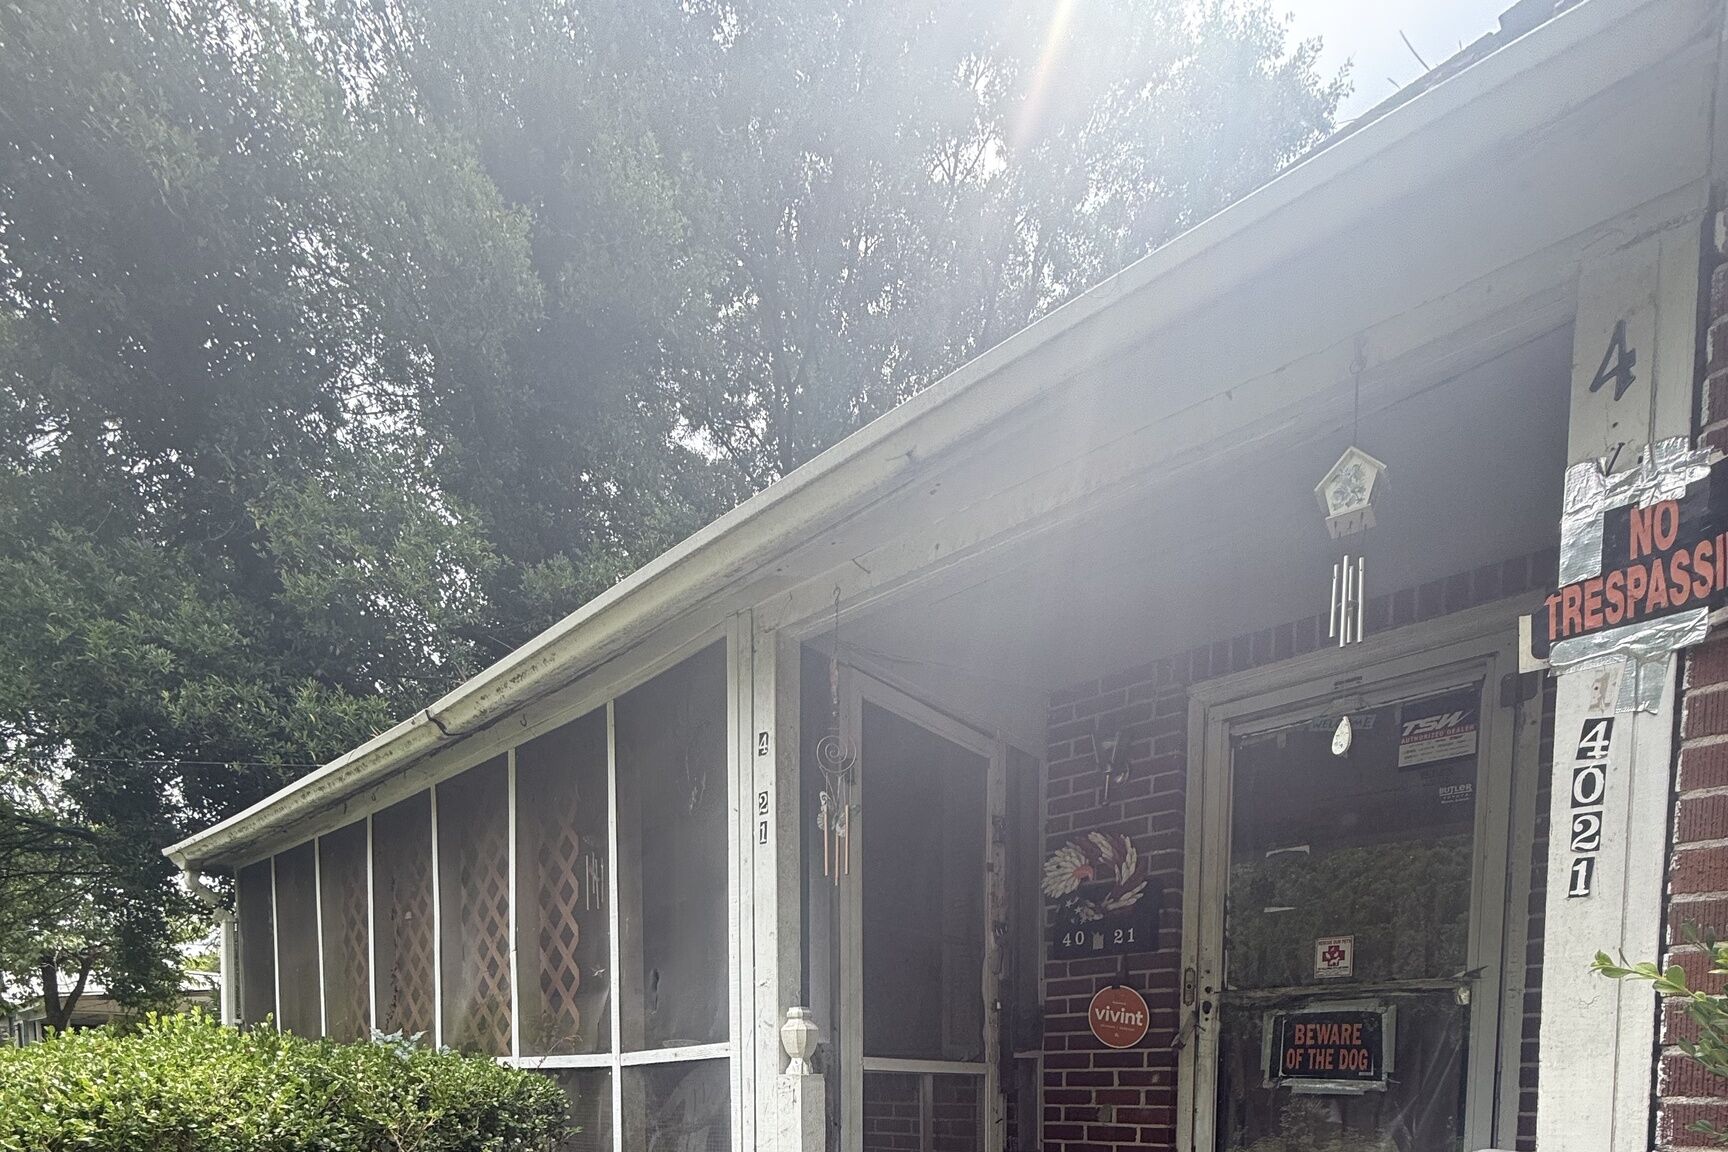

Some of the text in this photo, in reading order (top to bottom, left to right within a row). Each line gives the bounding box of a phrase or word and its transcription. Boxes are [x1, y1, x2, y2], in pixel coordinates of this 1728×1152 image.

[1589, 319, 1636, 401] 4
[1630, 498, 1680, 560] NO
[1544, 531, 1728, 640] TRESPASSI
[1312, 714, 1376, 730] WELME
[1401, 724, 1474, 744] AUTHORIZED DEALER
[1402, 710, 1474, 736] TSW
[1569, 720, 1610, 896] 4021
[1094, 1005, 1144, 1026] vivint
[1294, 1023, 1363, 1045] BEWARE
[1286, 1048, 1369, 1070] OF THE DOG
